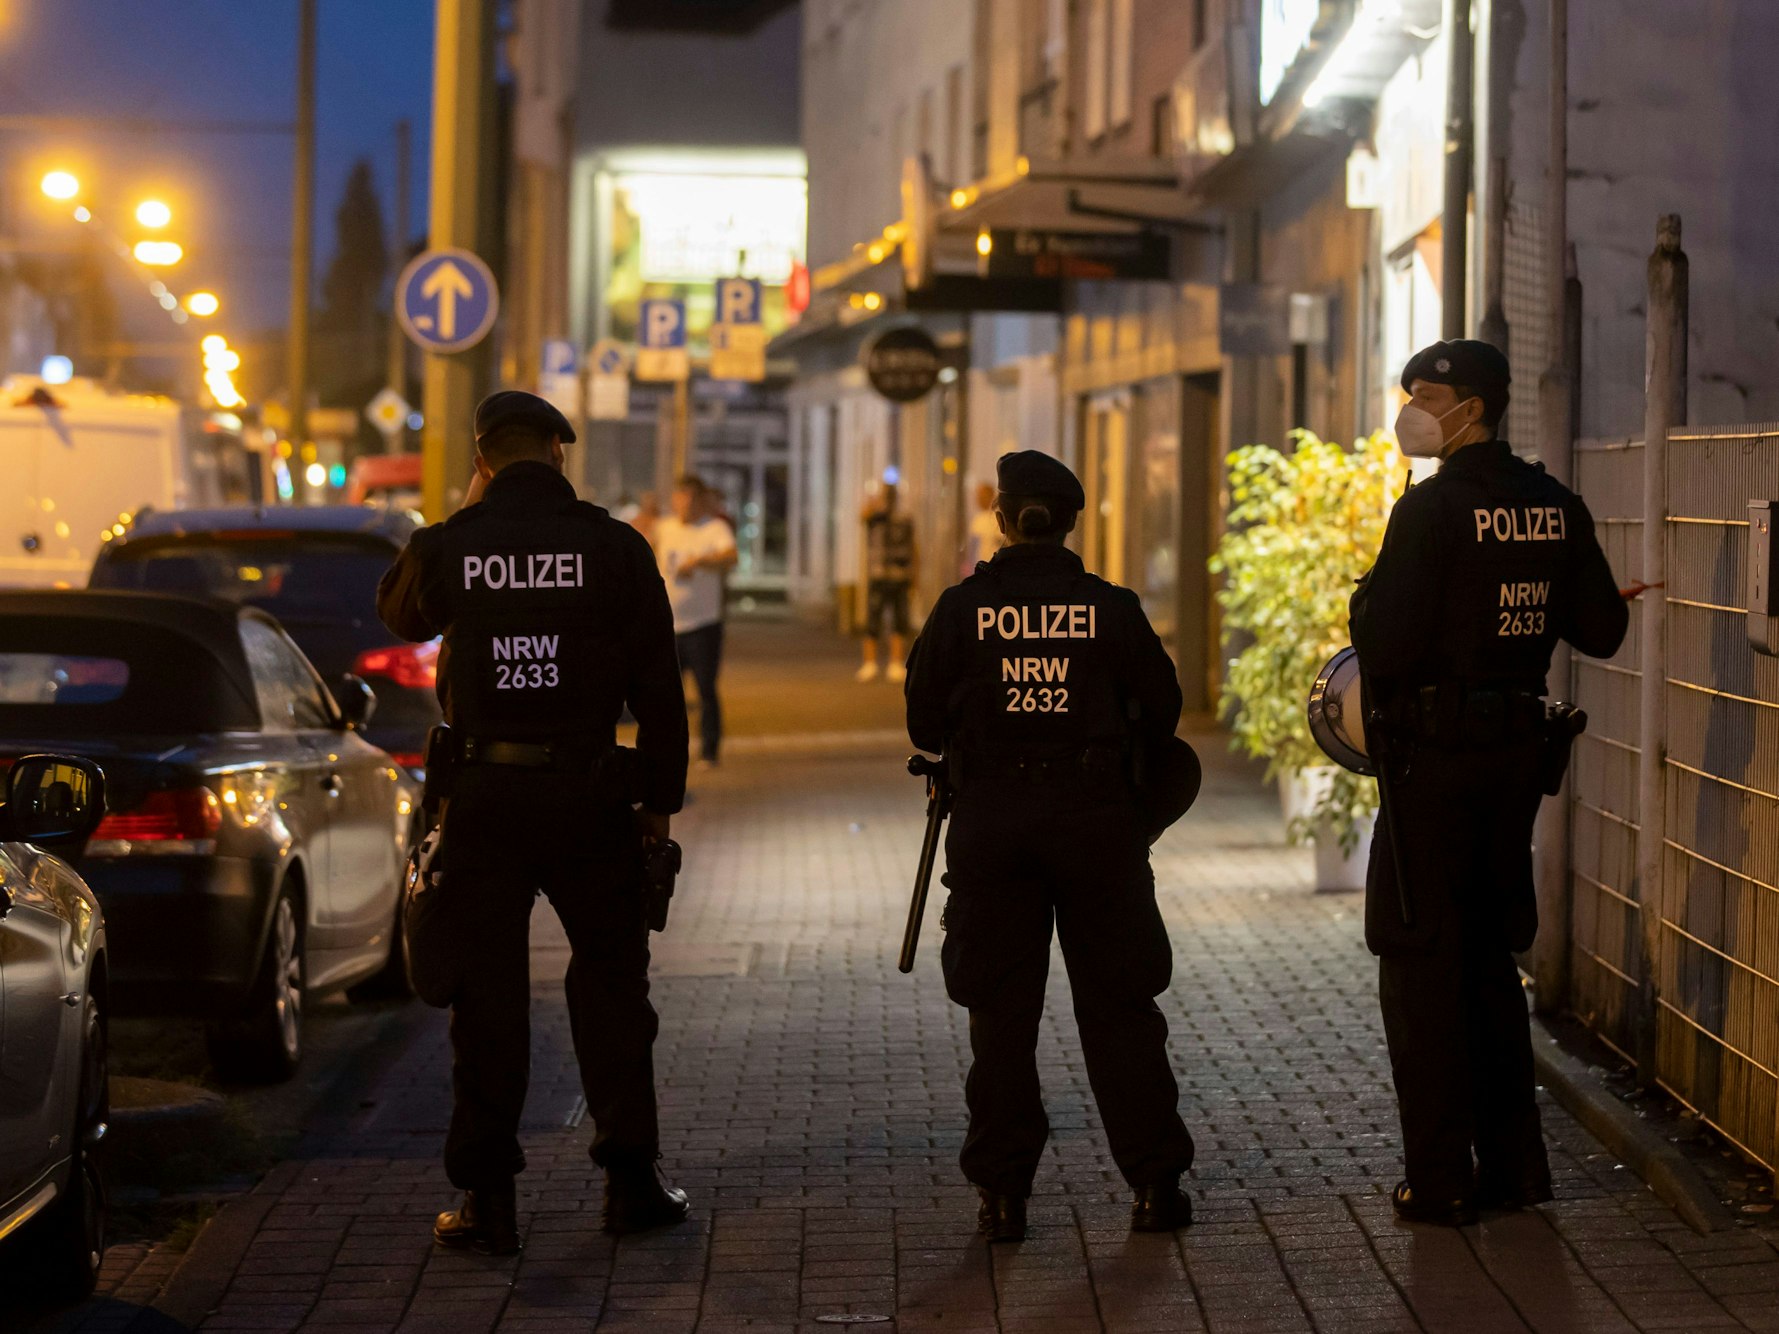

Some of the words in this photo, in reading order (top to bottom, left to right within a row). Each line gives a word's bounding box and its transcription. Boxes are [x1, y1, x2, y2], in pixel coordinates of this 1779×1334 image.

[1473, 507, 1566, 542] POLIZEI
[464, 553, 583, 590] POLIZEI
[1499, 581, 1550, 607] NRW
[977, 604, 1096, 641] POLIZEI
[1498, 611, 1546, 636] 2633
[492, 634, 559, 660] NRW
[496, 662, 560, 689] 2633
[1001, 657, 1069, 683] NRW
[1006, 687, 1069, 713] 2632
